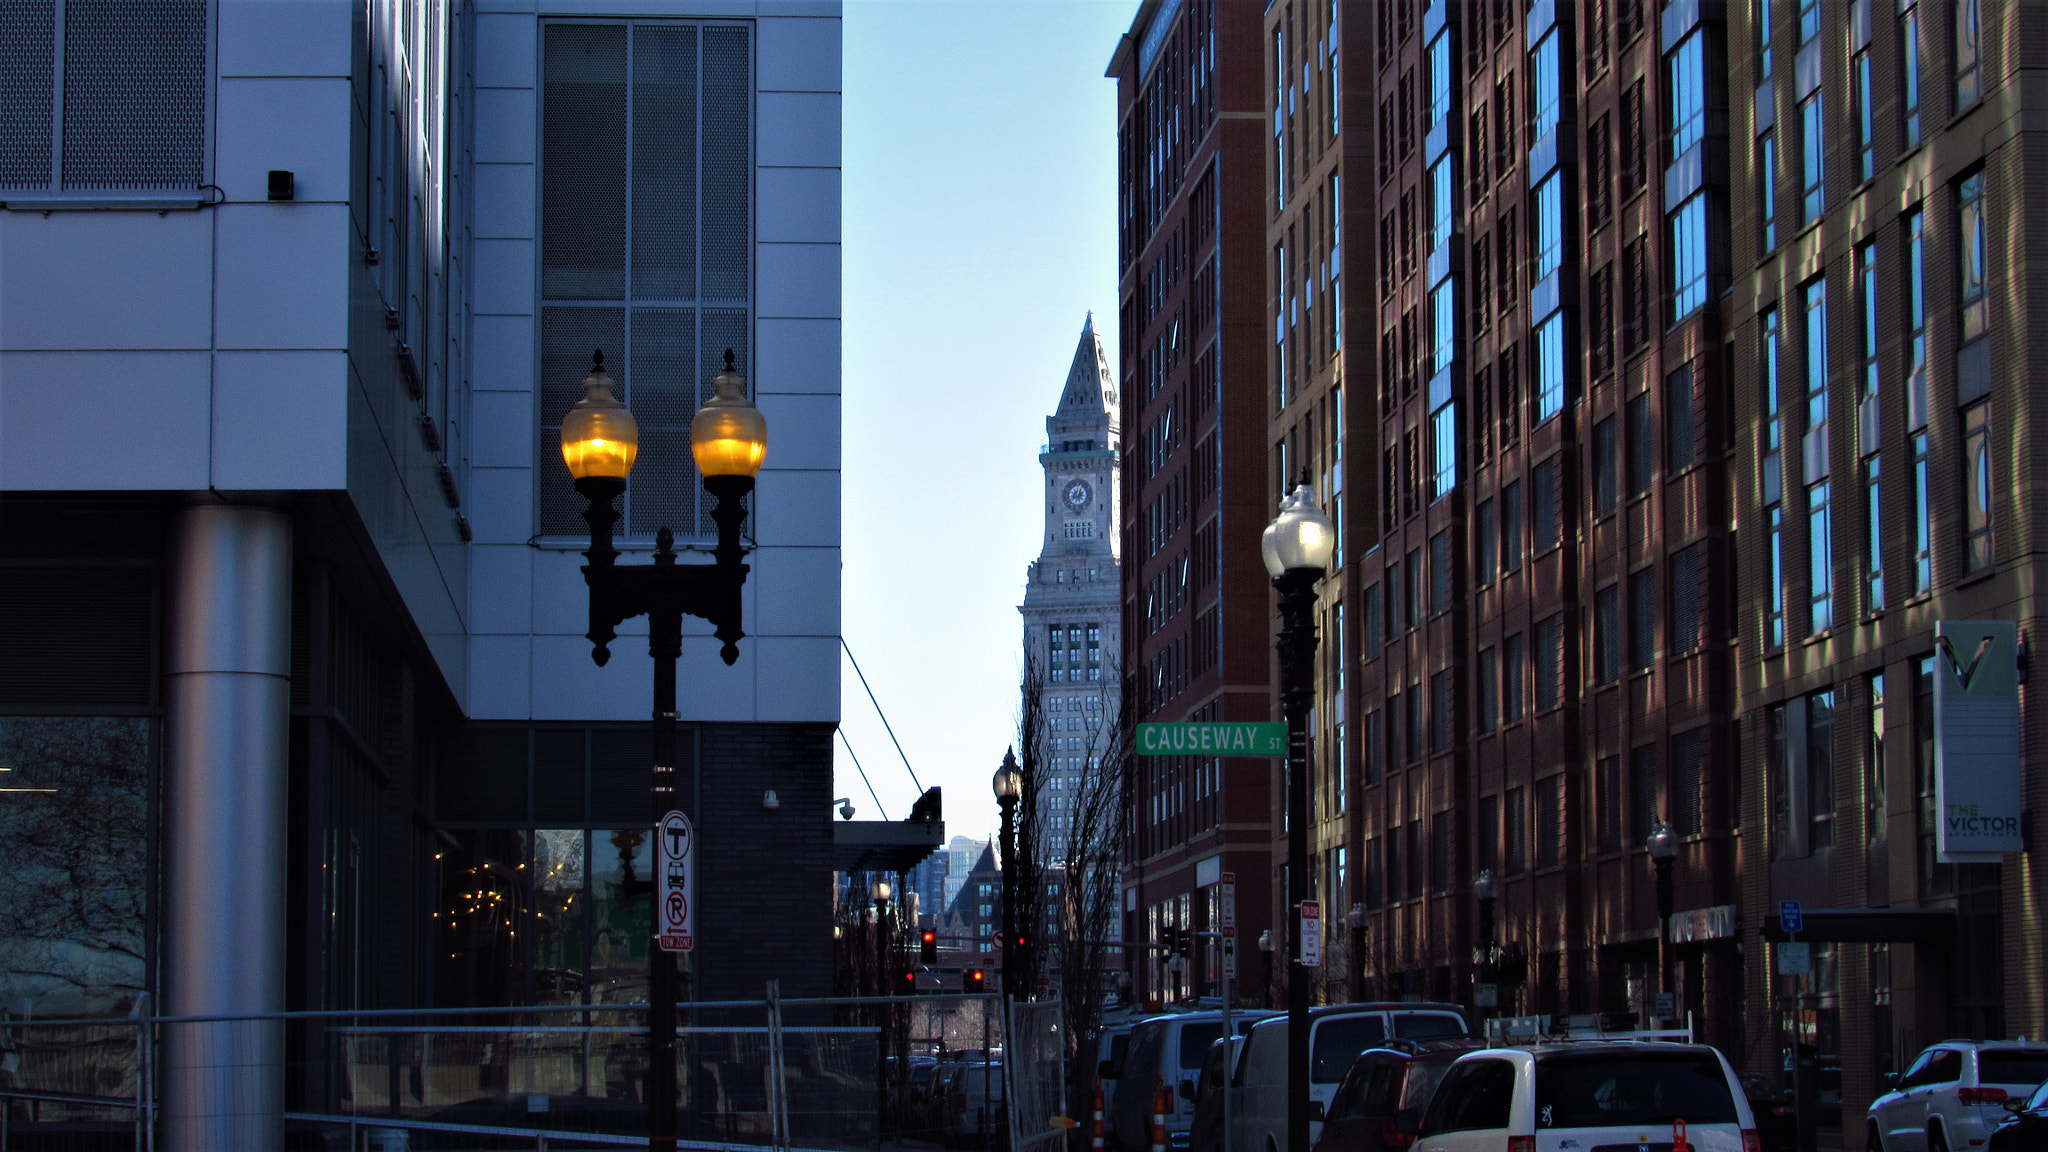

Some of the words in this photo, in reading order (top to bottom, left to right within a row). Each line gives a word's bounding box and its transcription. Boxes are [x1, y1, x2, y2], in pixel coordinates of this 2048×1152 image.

[1144, 726, 1258, 750] CAUSEWAY
[1269, 737, 1281, 750] ST
[1948, 804, 1978, 816] THE
[1948, 817, 2017, 831] VICTOR
[667, 827, 686, 855] T
[662, 936, 674, 948] TOW
[676, 936, 691, 949] ZONE
